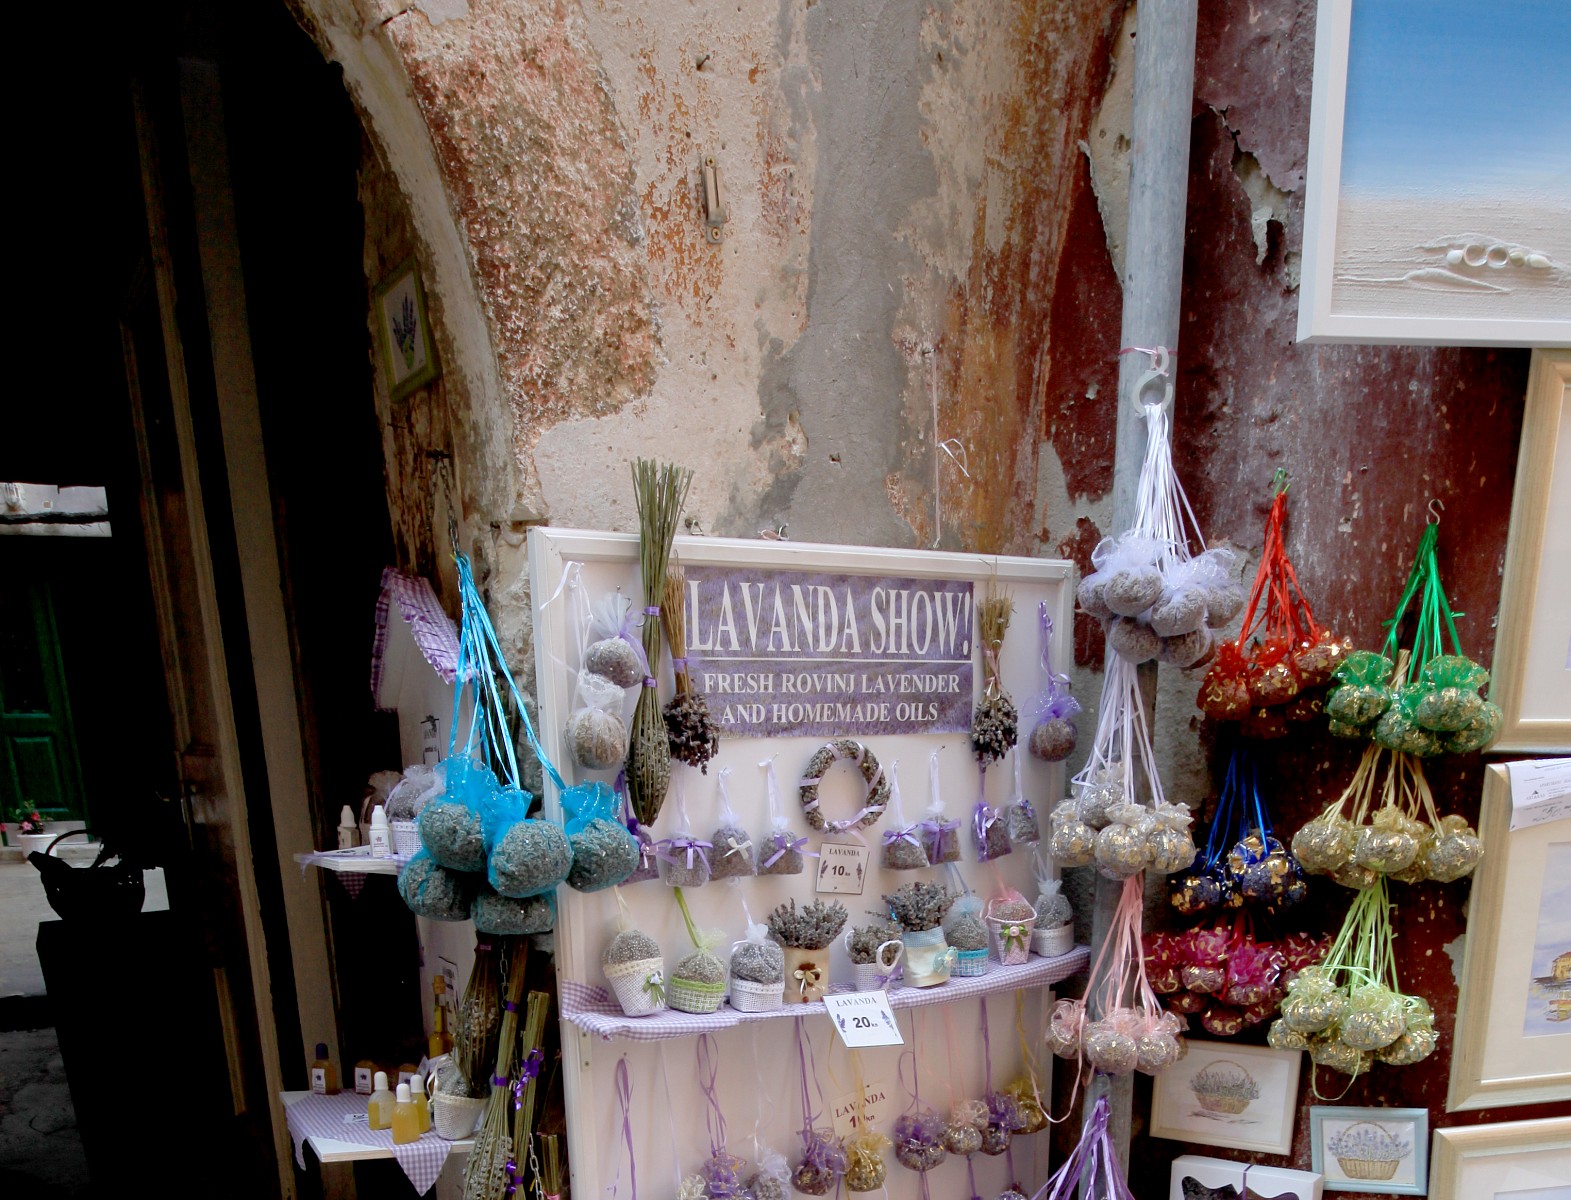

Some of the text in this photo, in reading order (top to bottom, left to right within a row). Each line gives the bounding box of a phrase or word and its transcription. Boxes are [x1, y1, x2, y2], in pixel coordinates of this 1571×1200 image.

[870, 586, 972, 655] SHOW!
[704, 673, 960, 695] FRESH ROVINJ LAVENDER
[721, 702, 938, 725] AND HOMEMADE OILS
[829, 848, 860, 857] LAVANDA
[832, 865, 845, 876] 10
[836, 996, 877, 1007] LAVANDA
[852, 1016, 871, 1029] 20
